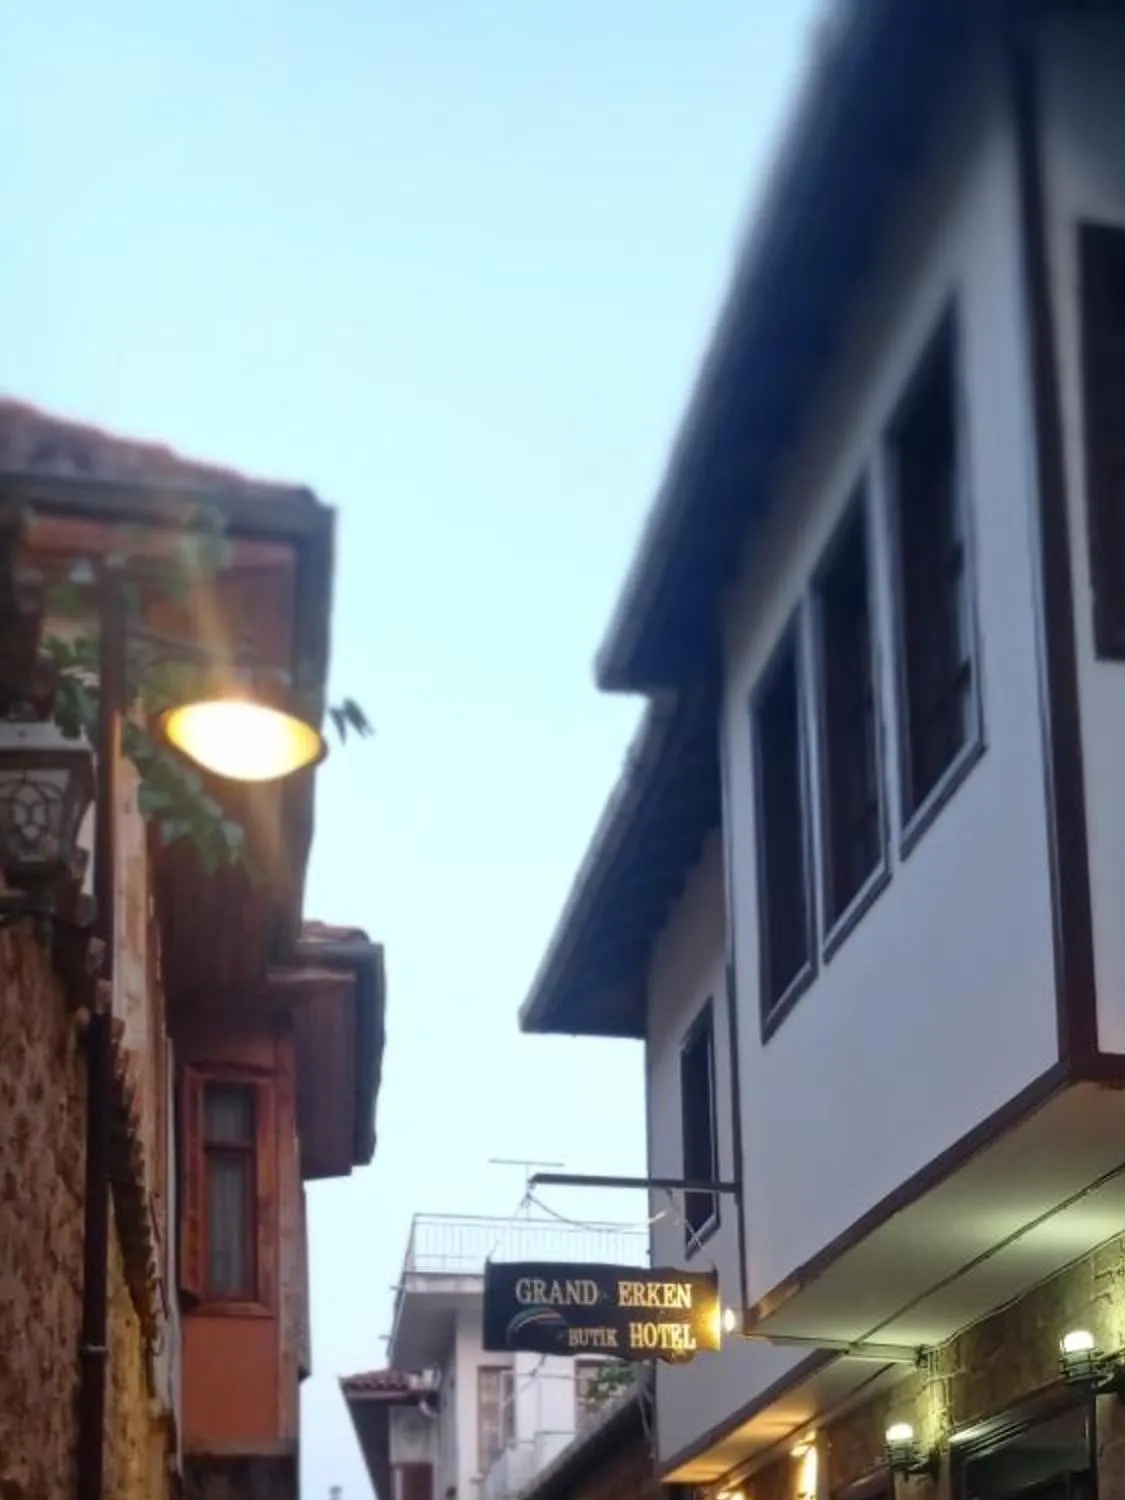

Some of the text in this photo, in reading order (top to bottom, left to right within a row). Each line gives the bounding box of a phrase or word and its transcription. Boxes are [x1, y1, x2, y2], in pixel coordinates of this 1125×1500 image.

[515, 1278, 692, 1309] GRAND ERKEN
[629, 1322, 696, 1350] HOTEL
